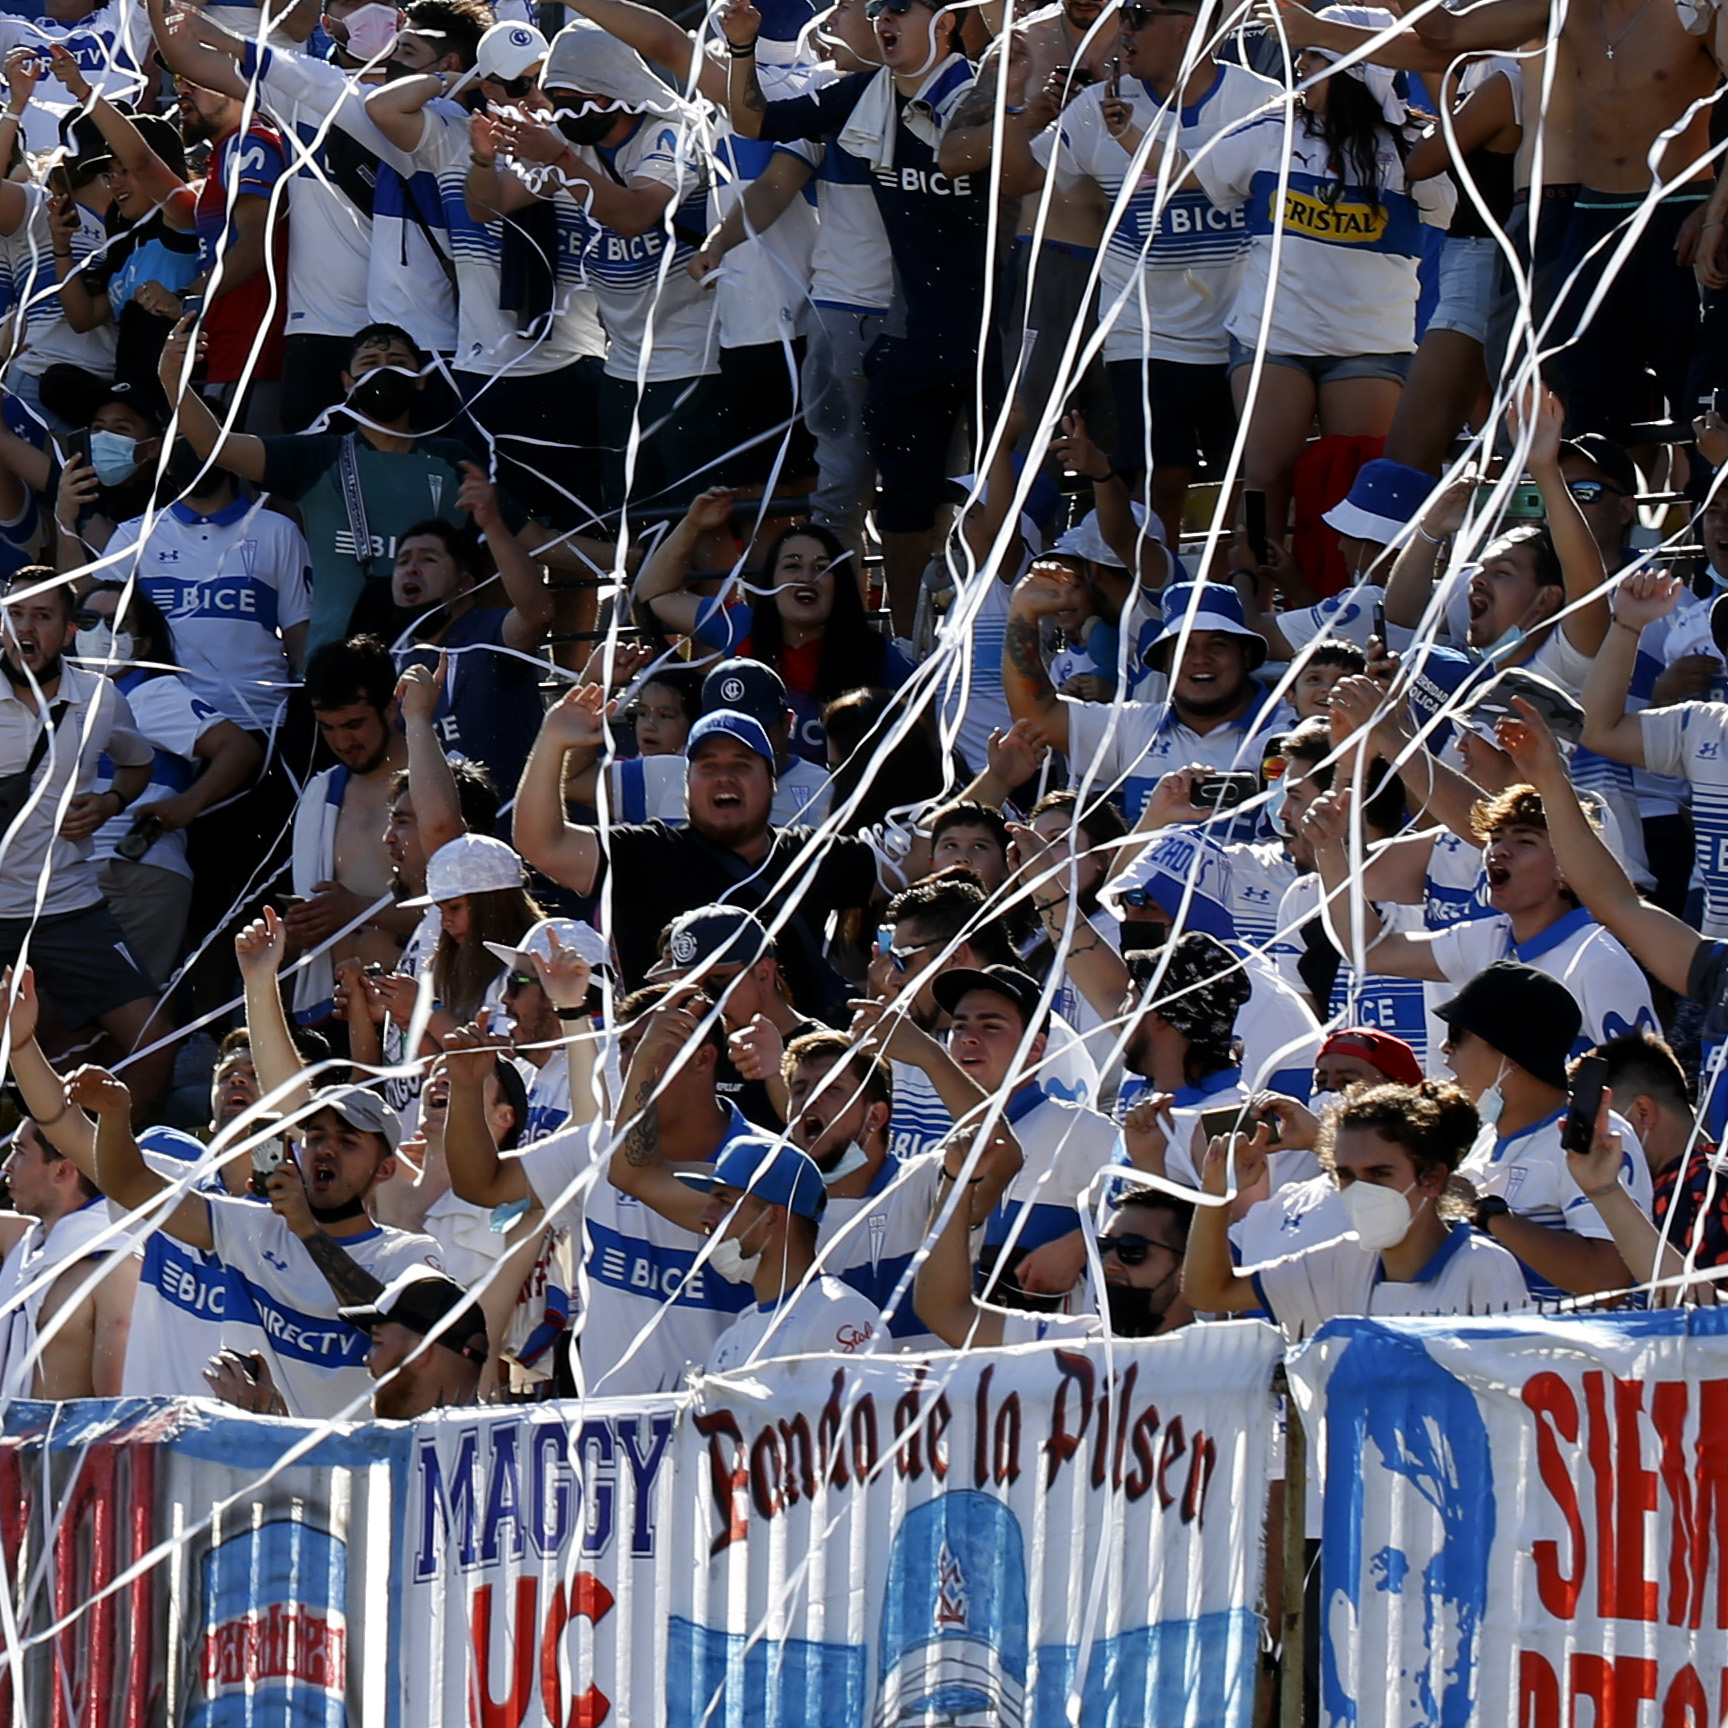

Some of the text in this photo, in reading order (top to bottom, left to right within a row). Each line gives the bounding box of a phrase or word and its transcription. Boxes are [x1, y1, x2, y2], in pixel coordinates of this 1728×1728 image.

[902, 169, 972, 196] BICE
[1172, 205, 1246, 233] BICE
[1283, 194, 1376, 240] CRISTAL
[606, 232, 658, 260] BICE
[182, 588, 256, 612] BICE
[631, 1259, 706, 1298] BICE
[893, 1360, 952, 1482] de
[1043, 1348, 1216, 1532] Pilsen
[414, 1412, 676, 1584] MAGGY
[469, 1571, 615, 1728] UC
